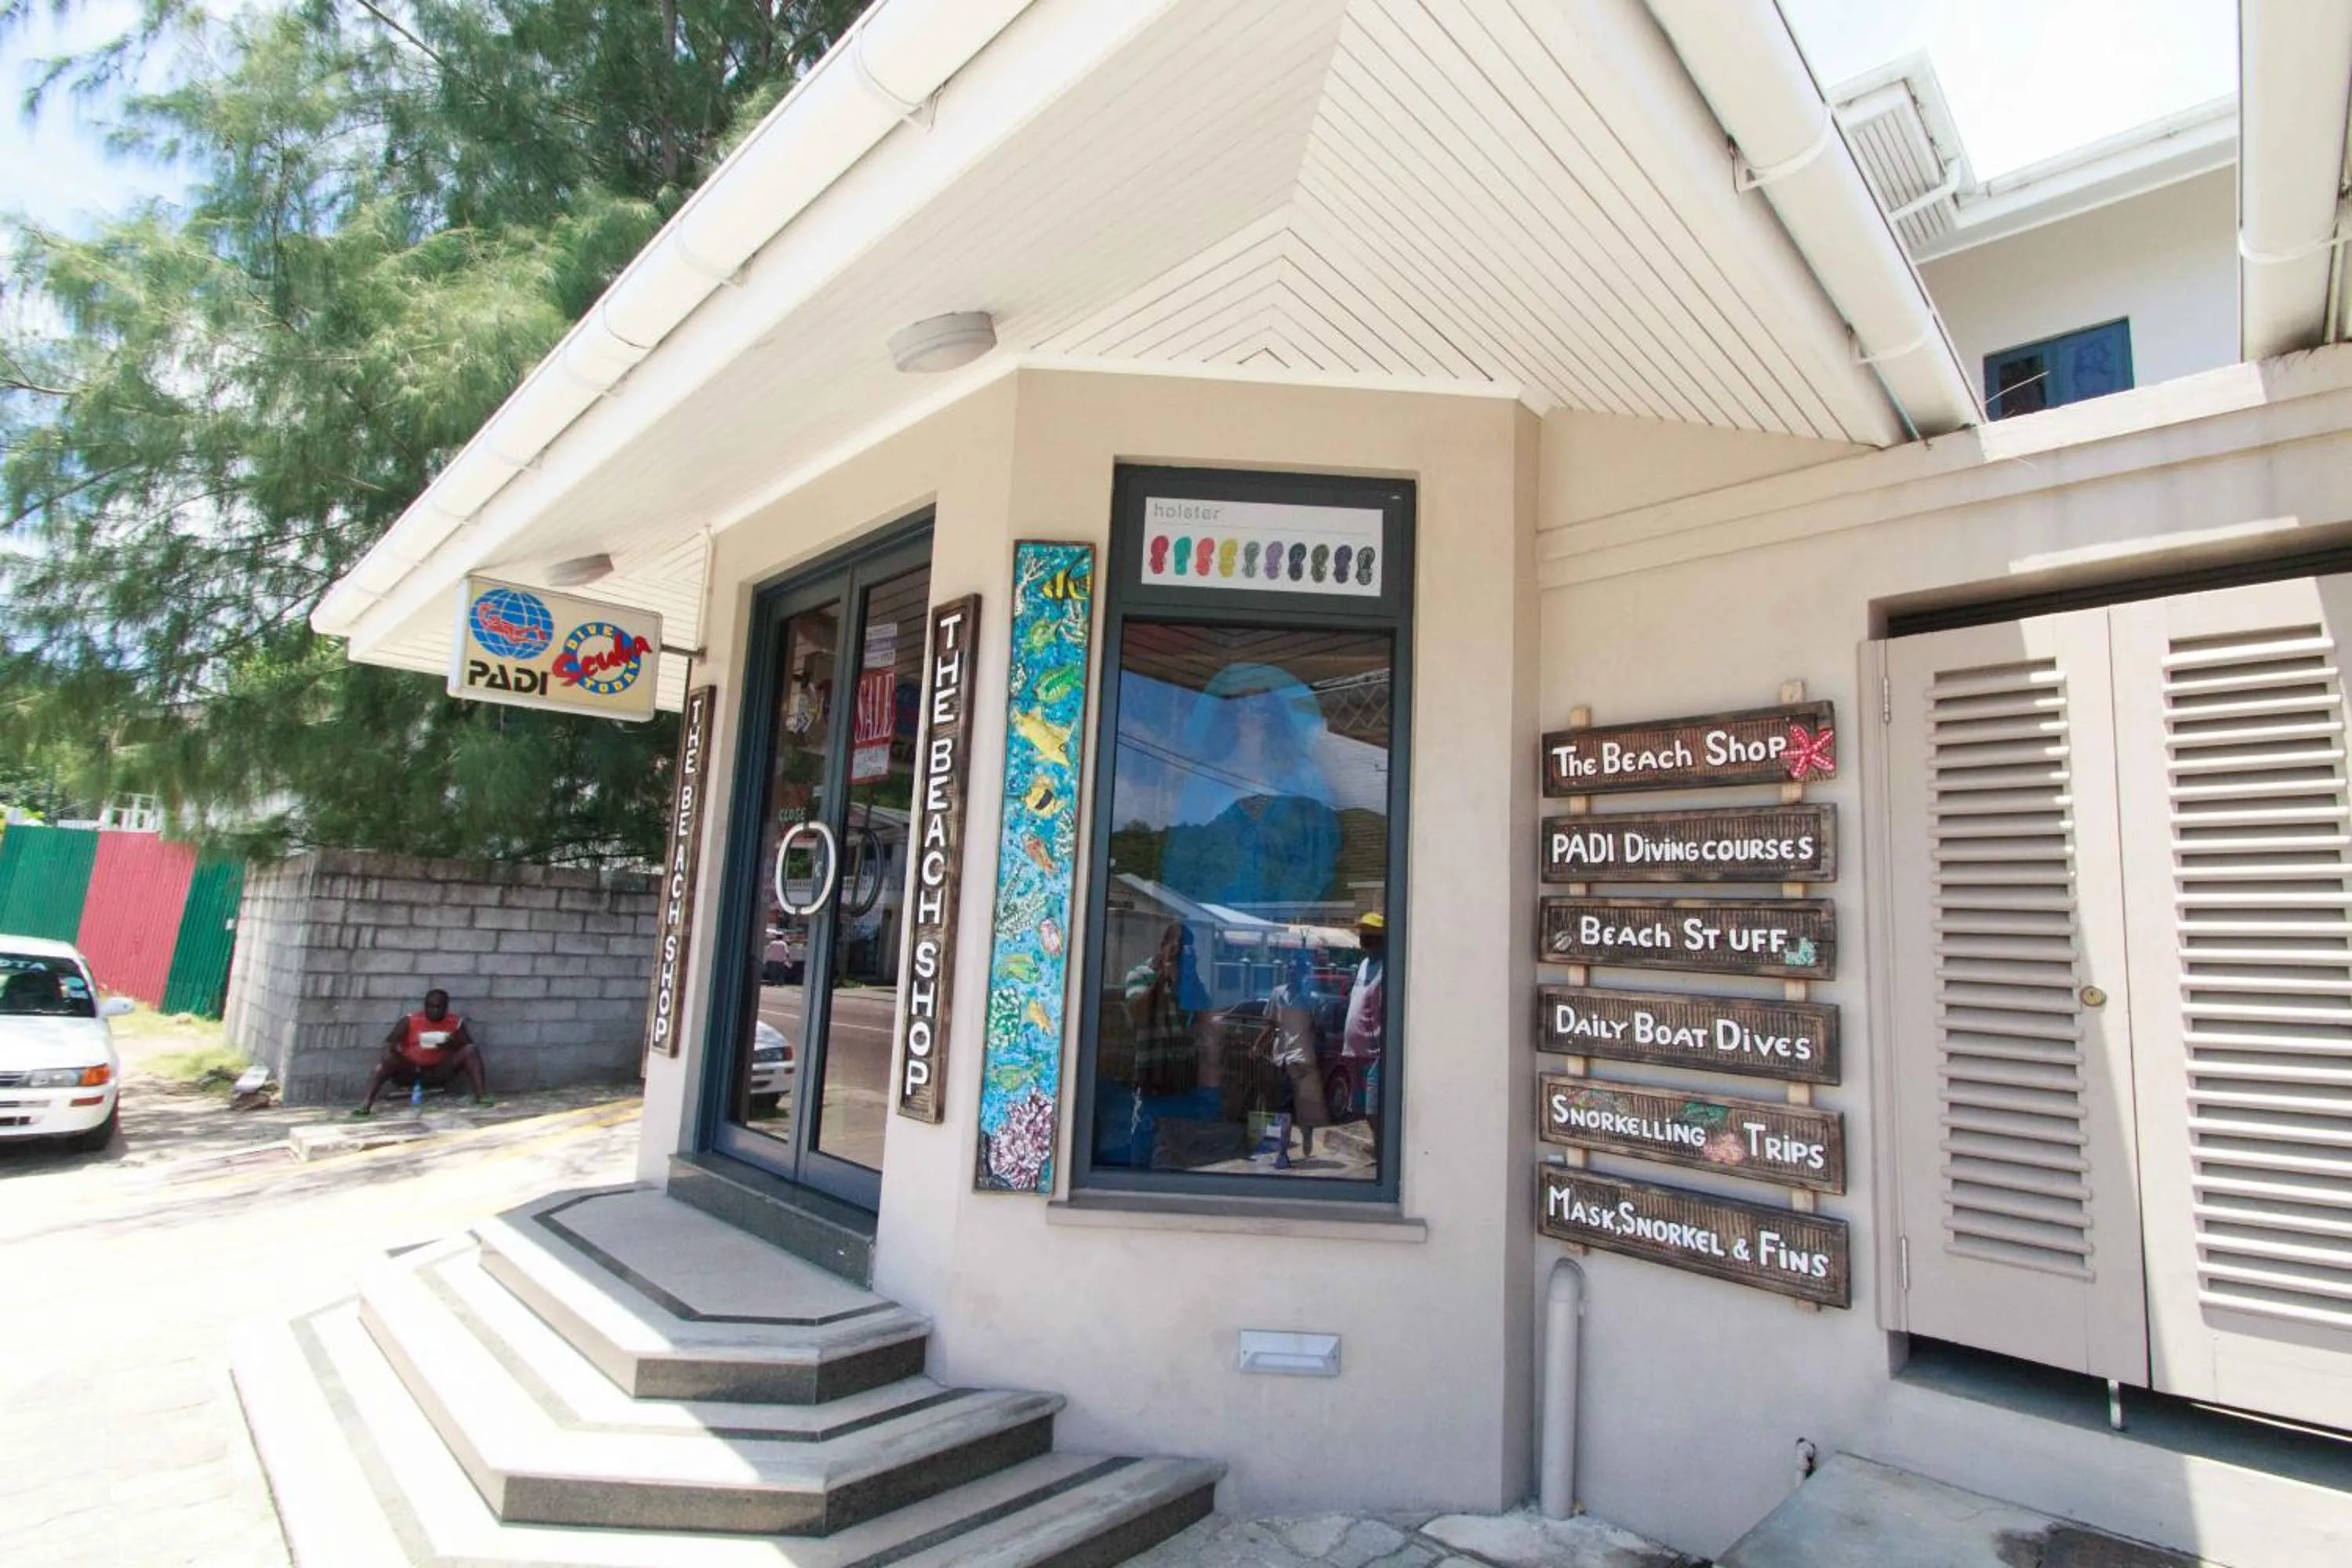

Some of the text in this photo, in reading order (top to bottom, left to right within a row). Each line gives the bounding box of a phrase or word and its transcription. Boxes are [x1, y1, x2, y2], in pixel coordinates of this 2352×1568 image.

[1153, 502, 1221, 521] holster
[567, 626, 614, 651] DIVE
[551, 631, 652, 687] Scuba
[467, 659, 548, 695] PADI
[584, 661, 638, 694] TODAY
[906, 614, 961, 1096] THE BEACH SHOP
[1552, 833, 1614, 863] PADI
[655, 699, 702, 1042] THE BEACH SHOP
[1733, 1237, 1751, 1262] &
